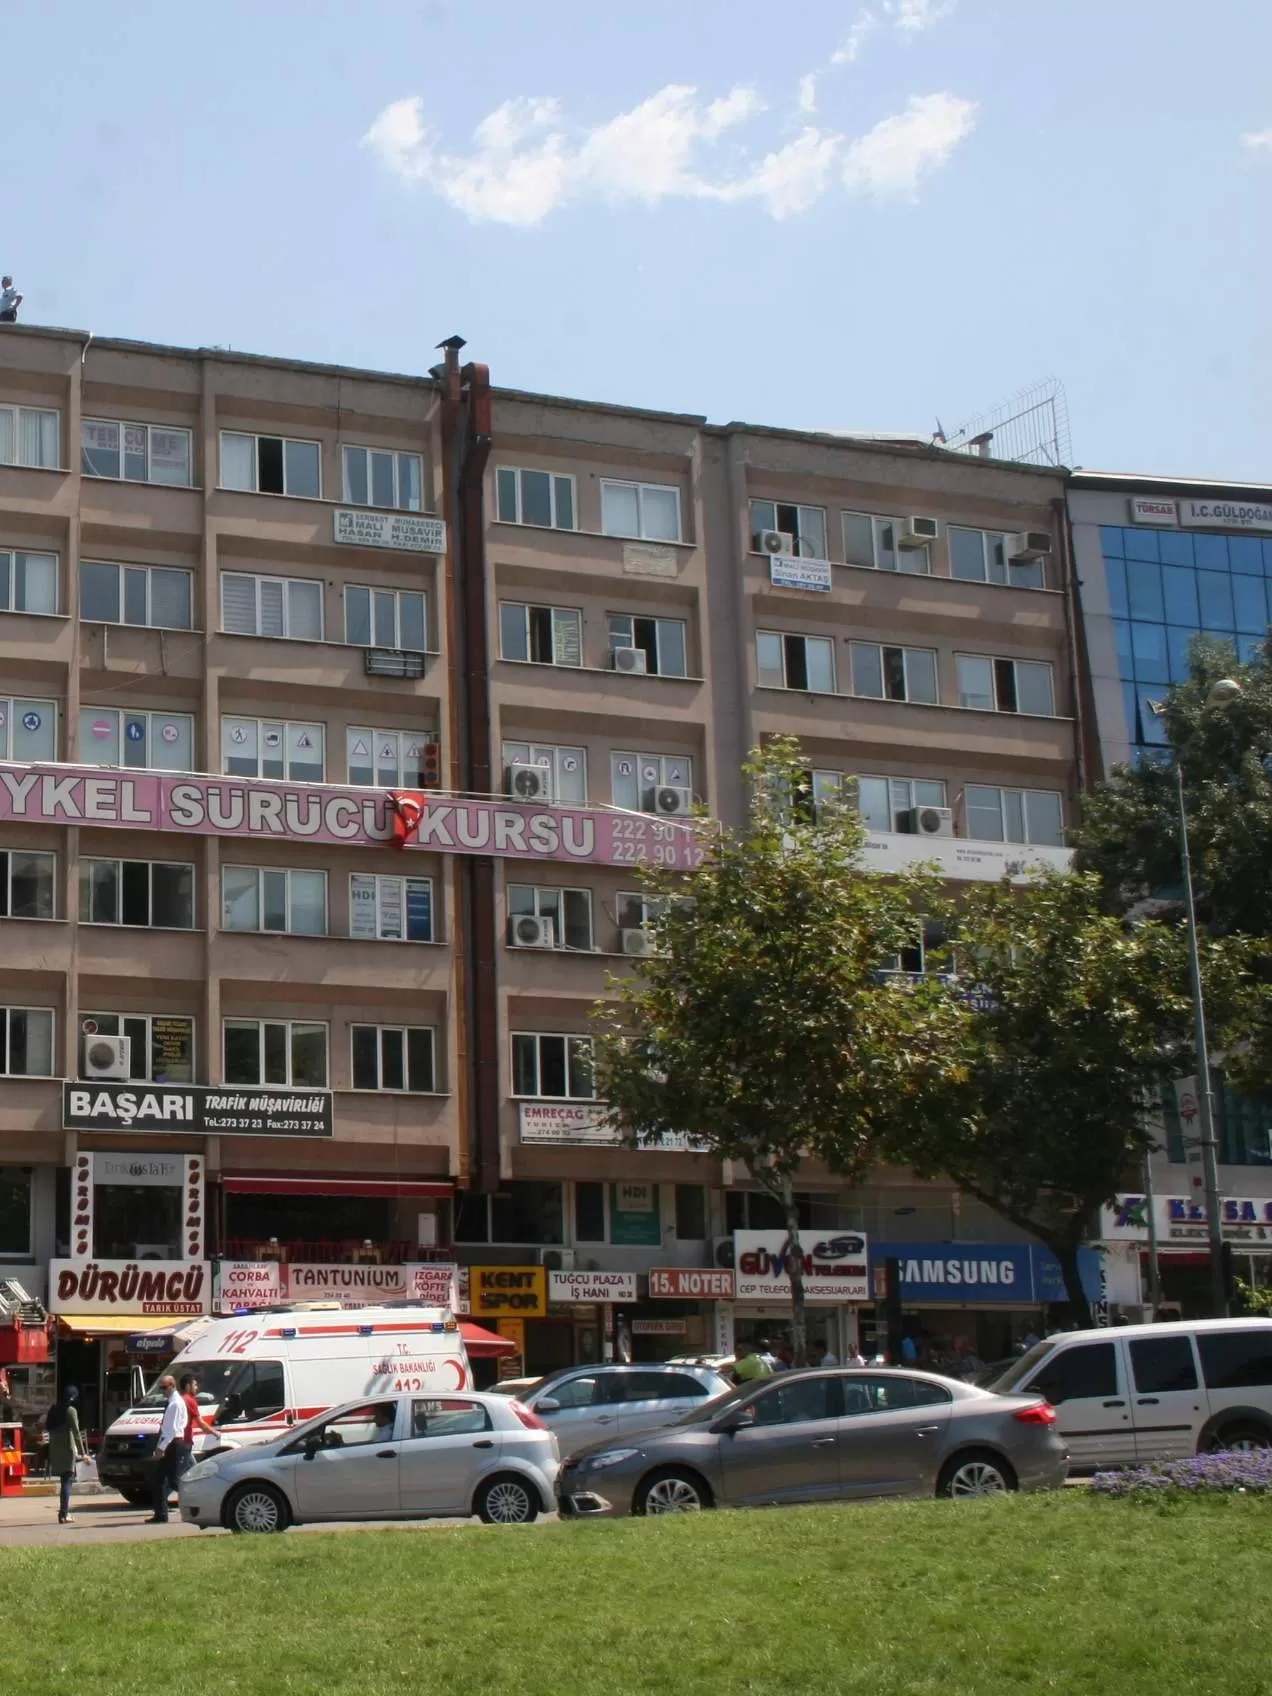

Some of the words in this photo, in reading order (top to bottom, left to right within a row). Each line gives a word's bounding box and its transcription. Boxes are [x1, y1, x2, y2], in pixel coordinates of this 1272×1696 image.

[418, 806, 595, 857] KURSU
[612, 818, 645, 838] 222
[612, 842, 647, 862] 222
[655, 846, 676, 863] 90
[69, 1091, 193, 1125] BAŞARI
[205, 1095, 247, 1110] TRAFİK
[249, 1095, 324, 1114] MÜŞAVİRLİĞİ
[239, 1118, 249, 1128] 37
[251, 1119, 262, 1128] 23
[302, 1120, 312, 1129] 37
[314, 1121, 325, 1130] 24
[57, 1263, 204, 1304] DÜRÜMCÜ
[481, 1272, 536, 1288] KENT
[554, 1272, 590, 1284] TUĞCU
[593, 1274, 624, 1285] PLAZA
[651, 1273, 674, 1293] 15.
[679, 1273, 731, 1293] NOTER
[222, 1288, 278, 1298] KAHVALTI
[570, 1287, 581, 1299] İŞ
[583, 1288, 609, 1298] HANI
[740, 1284, 756, 1293] CEP
[144, 1304, 171, 1313] TARIK
[480, 1293, 539, 1310] SPOR
[217, 1330, 259, 1353] 112
[372, 1363, 398, 1375] SAĞLIK
[399, 1362, 436, 1373] BAKANLIĞI
